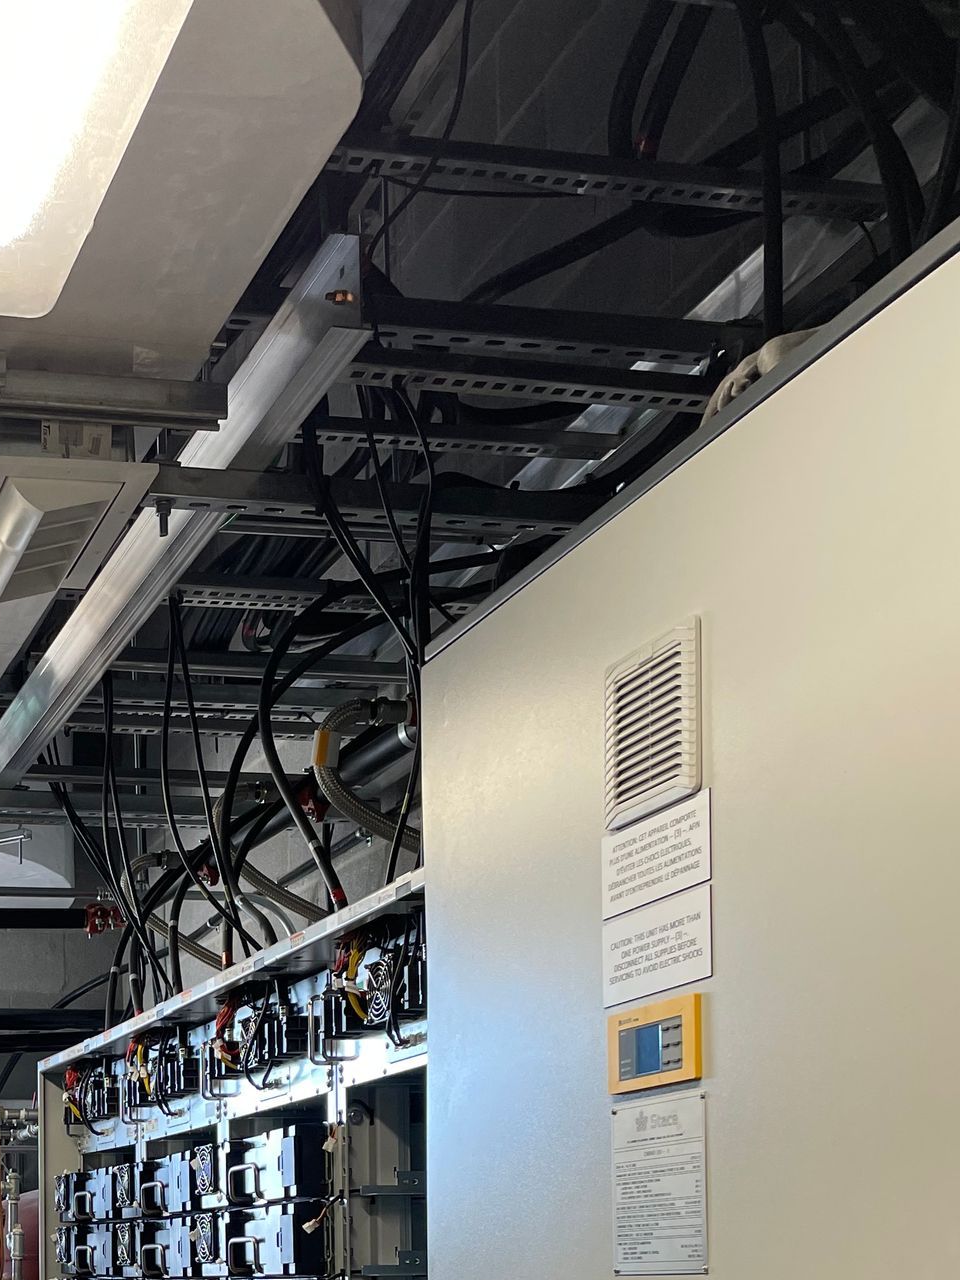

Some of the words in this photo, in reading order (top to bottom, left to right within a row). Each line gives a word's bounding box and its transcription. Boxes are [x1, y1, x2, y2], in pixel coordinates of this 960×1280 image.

[669, 809, 696, 828] COMPORTE
[634, 834, 668, 855] ALIMENTATION
[688, 820, 700, 831] AFIN
[634, 931, 644, 942] THIS
[646, 927, 657, 938] UNIT
[658, 922, 669, 933] HAS
[670, 917, 684, 929] MORE
[685, 911, 700, 924] THAN
[614, 955, 644, 973] DISCONNECT
[644, 951, 653, 962] ALL
[654, 944, 676, 959] SUPPLIES
[677, 936, 696, 951] BEFORE
[621, 948, 630, 959] ONE
[632, 941, 649, 955] POWER
[651, 934, 670, 948] SUPPLY
[609, 970, 633, 985] SERVICING
[634, 967, 641, 977] TO
[642, 961, 658, 974] AVOID
[659, 954, 681, 969] ELECTRIC
[682, 947, 702, 961] SHOCKS
